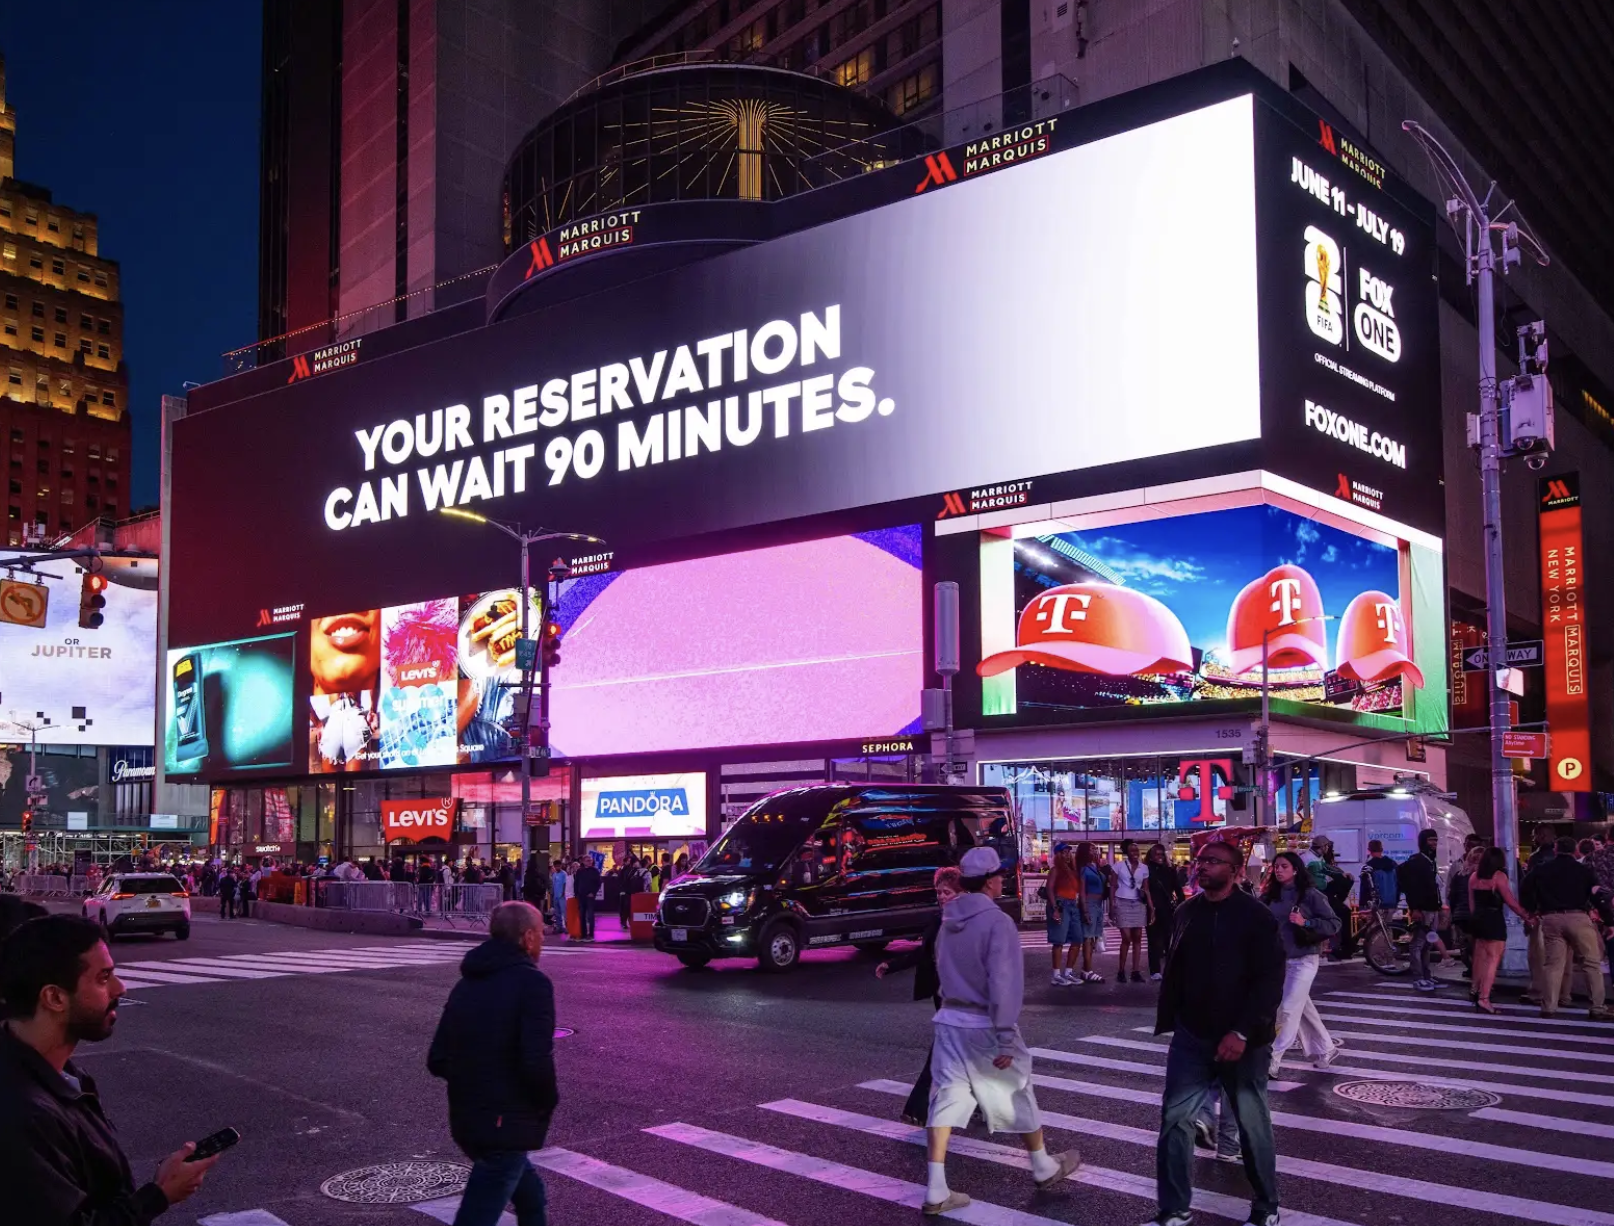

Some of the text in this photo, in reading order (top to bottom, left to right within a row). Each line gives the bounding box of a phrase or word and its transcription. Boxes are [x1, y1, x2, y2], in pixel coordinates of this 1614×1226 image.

[966, 118, 1058, 157] MARRIOTT
[966, 138, 1046, 173] MARQUIS
[1341, 137, 1386, 180] MARRIOTT
[1341, 154, 1382, 190] MARQUIS
[1290, 156, 1331, 207] JUNE
[1331, 186, 1346, 217] 11
[1356, 202, 1390, 245] JULY
[1389, 227, 1406, 256] 19
[560, 210, 641, 242] MARRIOTT
[560, 229, 630, 258] MARQUIS
[1359, 266, 1396, 319] FOX
[1316, 314, 1334, 333] FIFA
[1360, 311, 1396, 355] ONE
[314, 338, 362, 361] MARRIOTT
[314, 352, 357, 373] MARQUIS
[354, 303, 842, 472] YOUR RESERVATION
[1313, 352, 1396, 402] OFFICIAL STREAMING PLATFORM
[1304, 399, 1407, 469] FOXONE.COM
[323, 365, 897, 531] CAN WAIT 90 MINUTES.
[971, 481, 1033, 499] MARRIOTT
[1352, 480, 1384, 500] MARRIOTT
[1352, 491, 1381, 510] MARQUIS
[1547, 495, 1579, 506] MARRIOTT
[971, 493, 1026, 510] MARQUIS
[571, 551, 614, 566] MARRIOTT
[571, 561, 609, 575] MARQUIS
[1547, 549, 1562, 623] NEW YORK
[272, 603, 305, 615] MARRIOTT
[272, 611, 302, 622] MARQUIS
[1564, 545, 1582, 693] MARRIOTT MARQUIS
[30, 644, 112, 660] JUPITER
[64, 637, 80, 646] OR
[1507, 649, 1533, 661] WAY
[1215, 728, 1242, 739] 1535
[862, 741, 914, 754] SEPHORA
[112, 759, 156, 782] Paramoun
[1565, 762, 1576, 776] P
[600, 794, 684, 814] PANDORA
